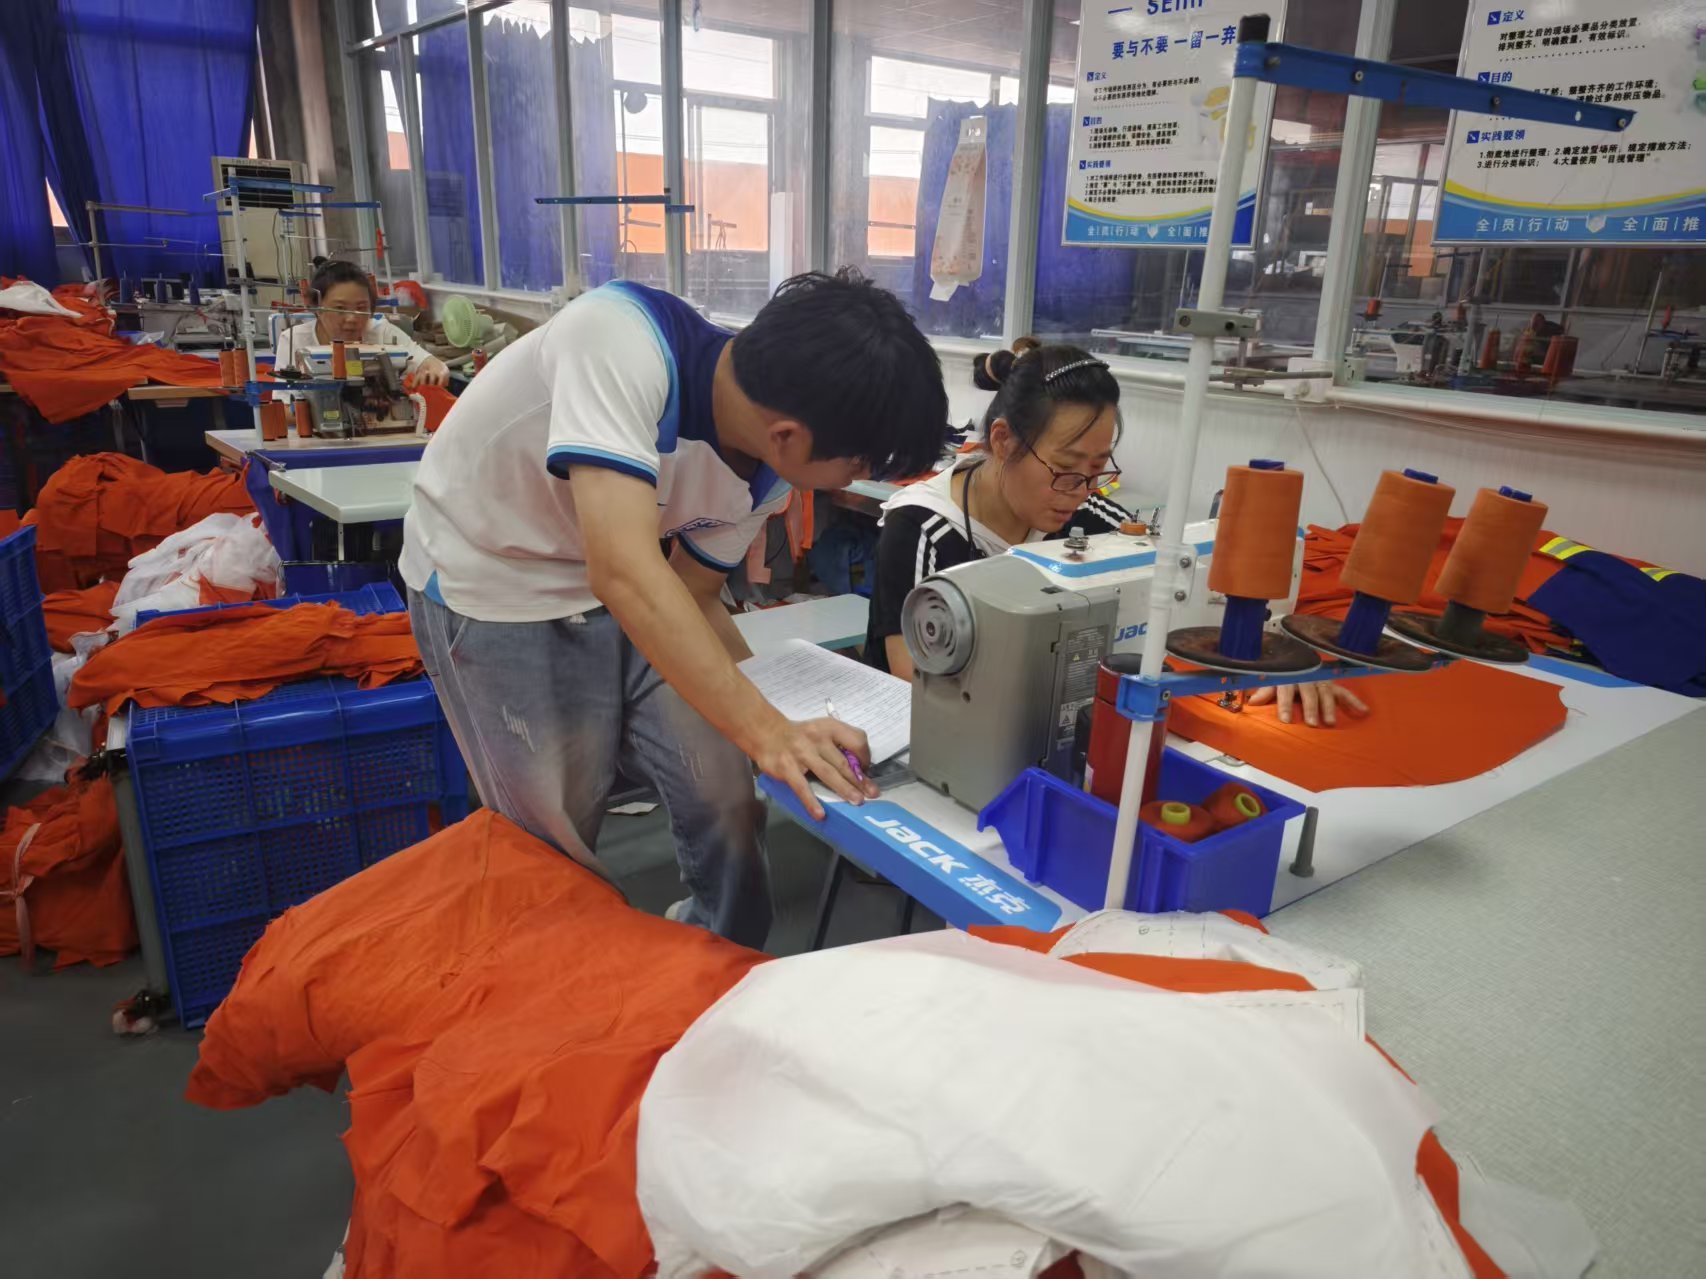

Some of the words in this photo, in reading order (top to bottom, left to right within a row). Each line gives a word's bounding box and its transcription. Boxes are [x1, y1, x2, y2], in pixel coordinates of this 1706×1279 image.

[1502, 10, 1525, 23] 定义
[1491, 70, 1513, 83] 目的
[1481, 129, 1526, 142] 实践要领
